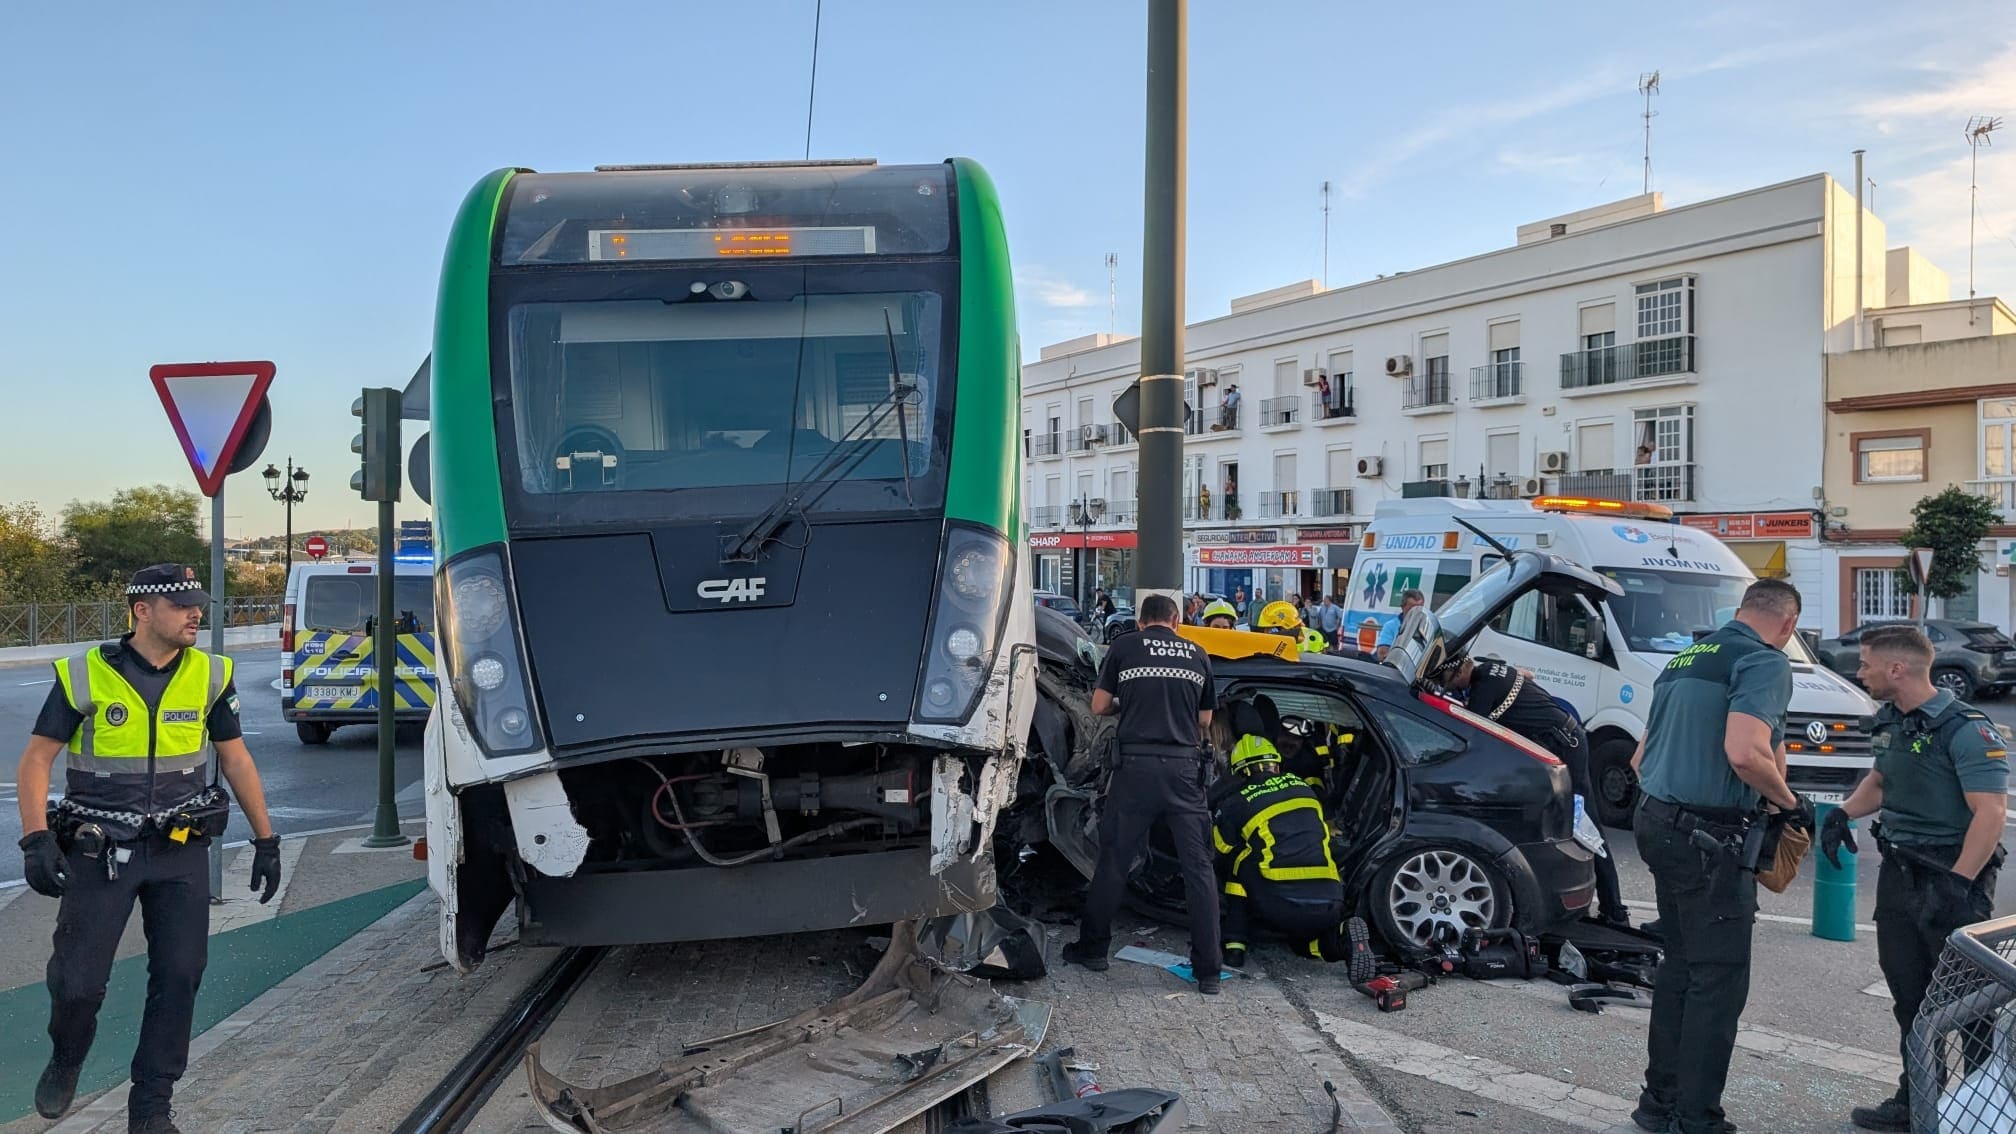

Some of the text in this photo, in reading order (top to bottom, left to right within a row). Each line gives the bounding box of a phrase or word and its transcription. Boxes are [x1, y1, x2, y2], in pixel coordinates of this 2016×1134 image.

[1766, 519, 1809, 527] JUNKERS
[1030, 537, 1061, 546] SHARP
[1197, 534, 1229, 542] SEGURIDAD
[1385, 535, 1437, 549] UNIDAD
[1249, 550, 1290, 561] AMSTERDAM
[697, 577, 766, 603] CAF
[1143, 638, 1197, 652] POLICIA
[1150, 647, 1193, 659] LOCAL
[1667, 655, 1696, 669] CIVIL
[303, 667, 372, 676] POLICIA
[1563, 679, 1586, 687] SALUD
[313, 688, 358, 697] 3380 KMJ
[164, 711, 197, 721] POLICIA
